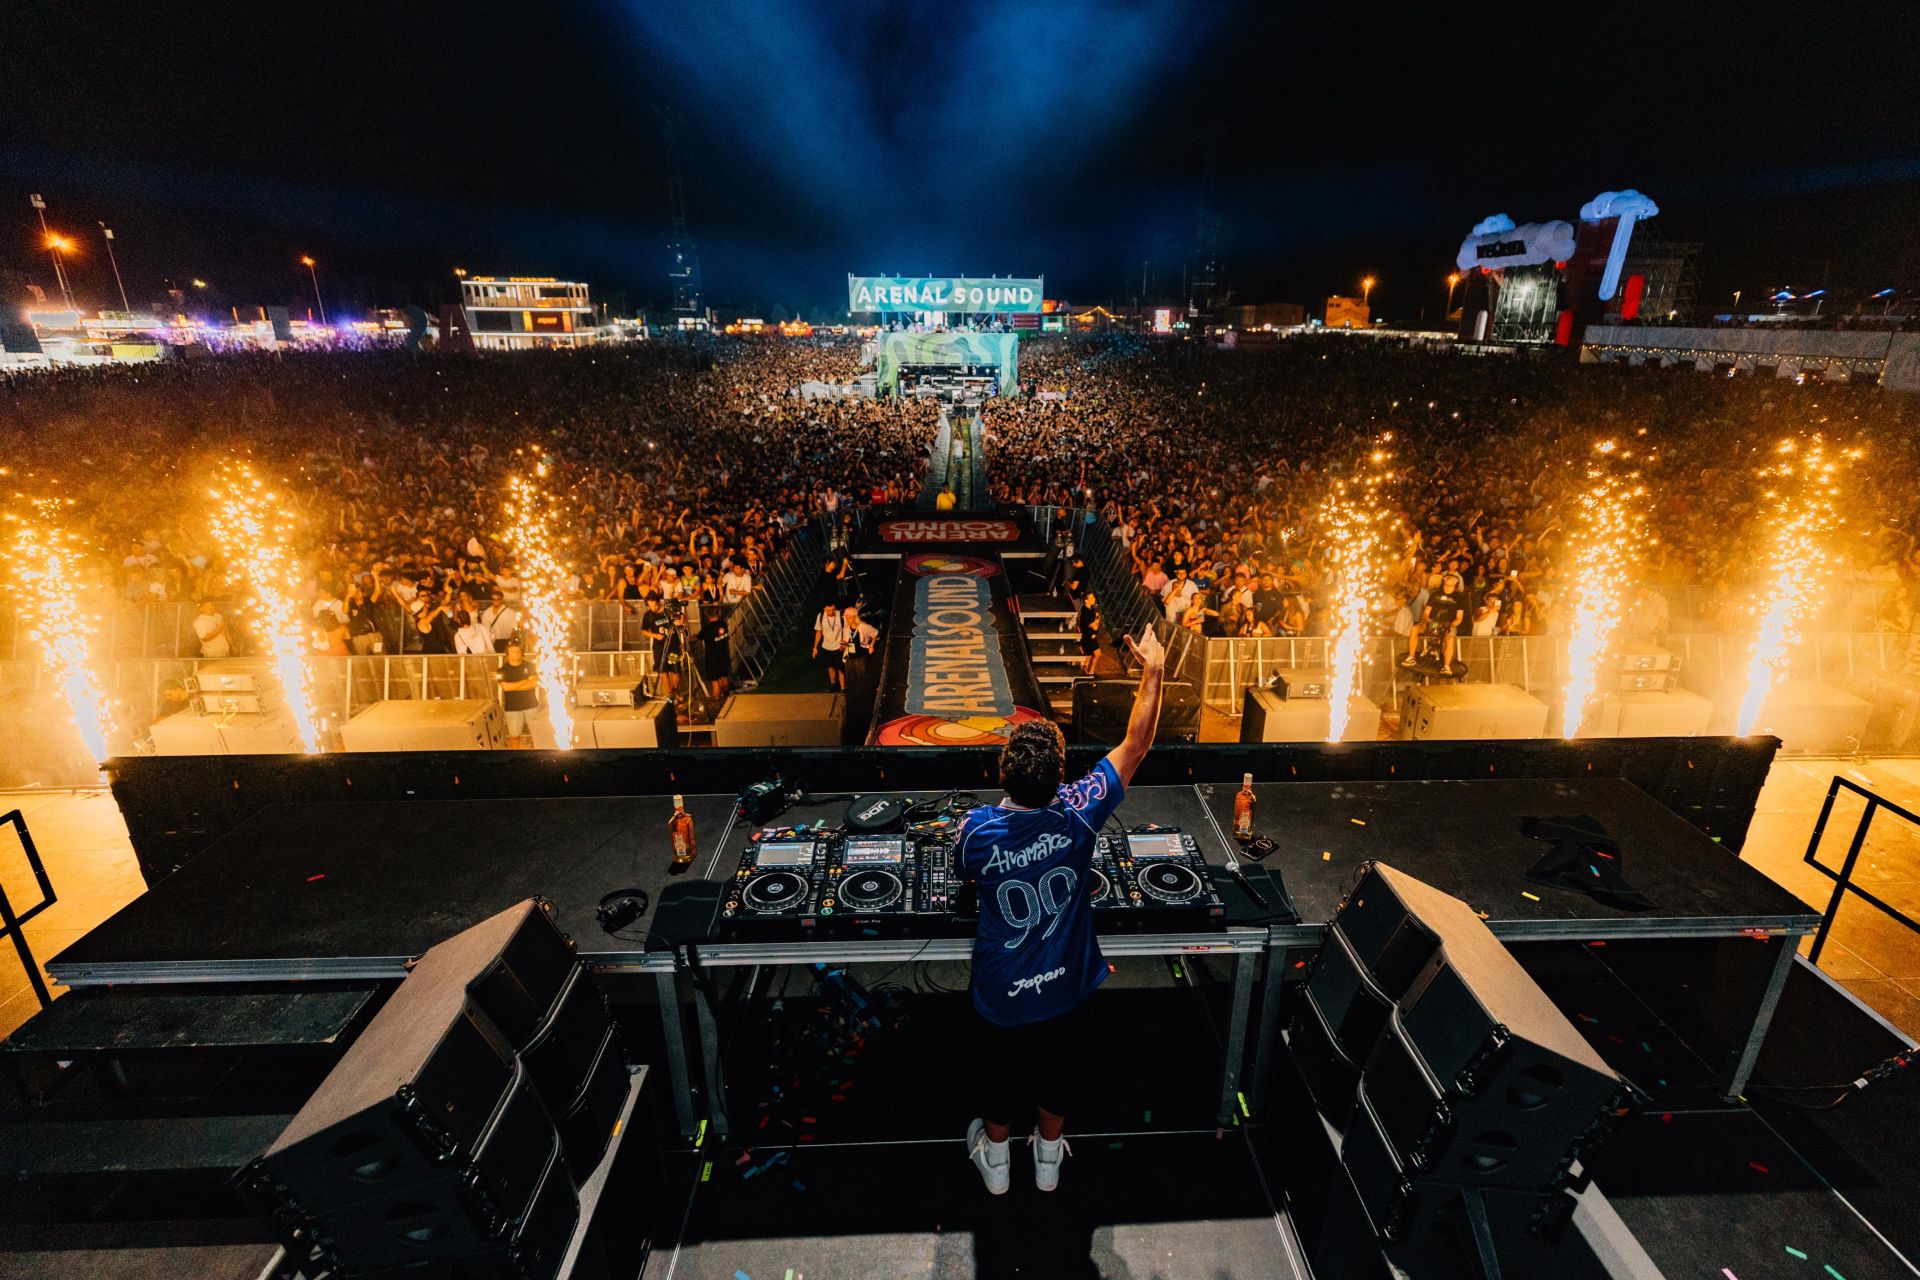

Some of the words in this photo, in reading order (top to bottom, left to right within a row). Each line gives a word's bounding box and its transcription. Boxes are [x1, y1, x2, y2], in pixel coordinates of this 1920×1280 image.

[857, 286, 948, 304] ARENAL
[954, 287, 1034, 304] SOUND
[889, 522, 1007, 531] SOUND
[889, 530, 1010, 540] ARENAL
[860, 801, 890, 821] UDG
[996, 866, 1078, 949] 99
[1007, 966, 1066, 997] Japan
